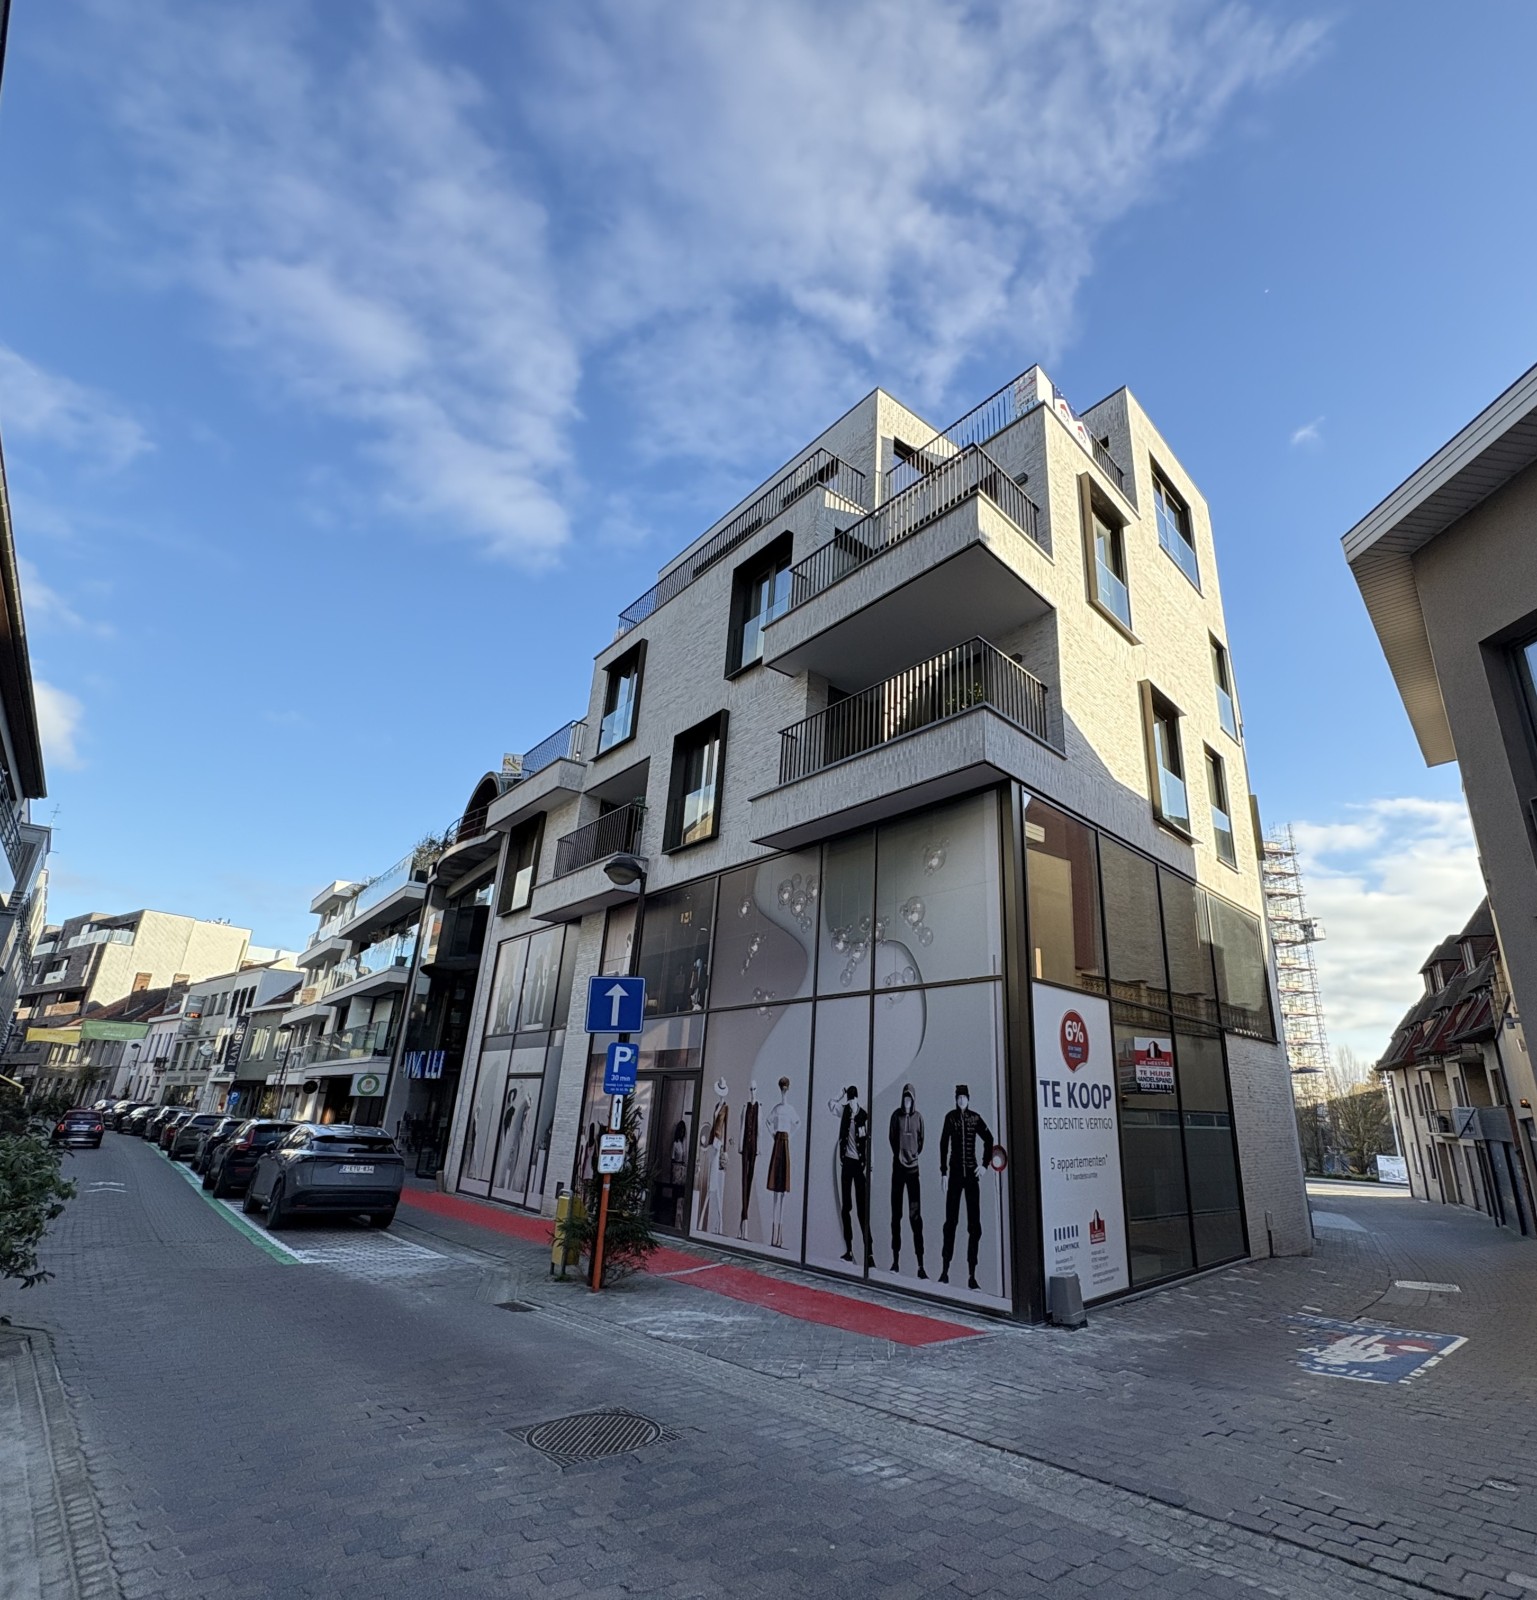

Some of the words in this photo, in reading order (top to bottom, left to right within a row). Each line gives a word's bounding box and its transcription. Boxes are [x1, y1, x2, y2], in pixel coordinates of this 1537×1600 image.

[227, 1022, 246, 1066] RAMSES
[1065, 1020, 1084, 1043] 6%
[613, 1046, 632, 1073] P
[1039, 1079, 1062, 1108] TE
[1067, 1081, 1112, 1110] KOOP
[1043, 1117, 1084, 1130] RESIDENTIE
[1085, 1117, 1113, 1130] VERTIGO
[1050, 1157, 1056, 1170] 5
